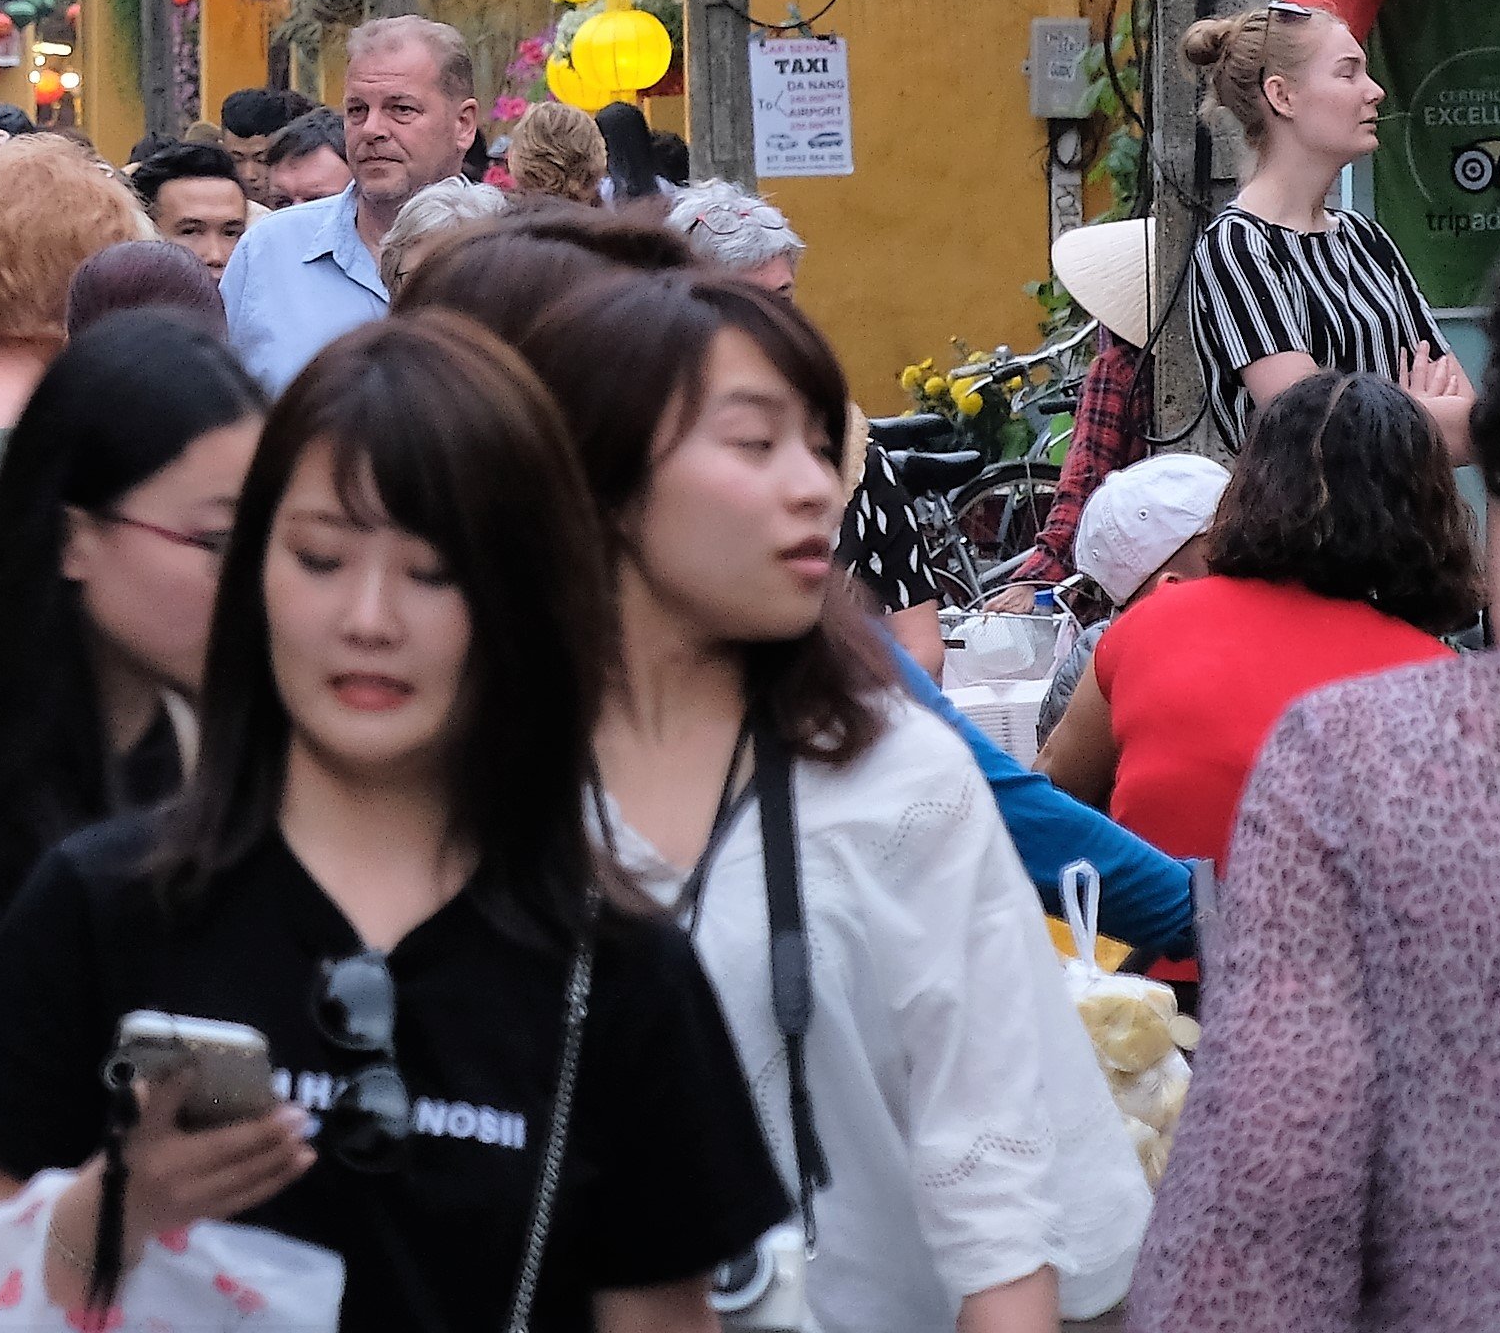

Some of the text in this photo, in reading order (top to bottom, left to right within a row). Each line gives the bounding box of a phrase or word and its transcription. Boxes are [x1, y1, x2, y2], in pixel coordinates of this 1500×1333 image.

[774, 58, 829, 74] TAXI
[787, 79, 845, 91] DA NANG
